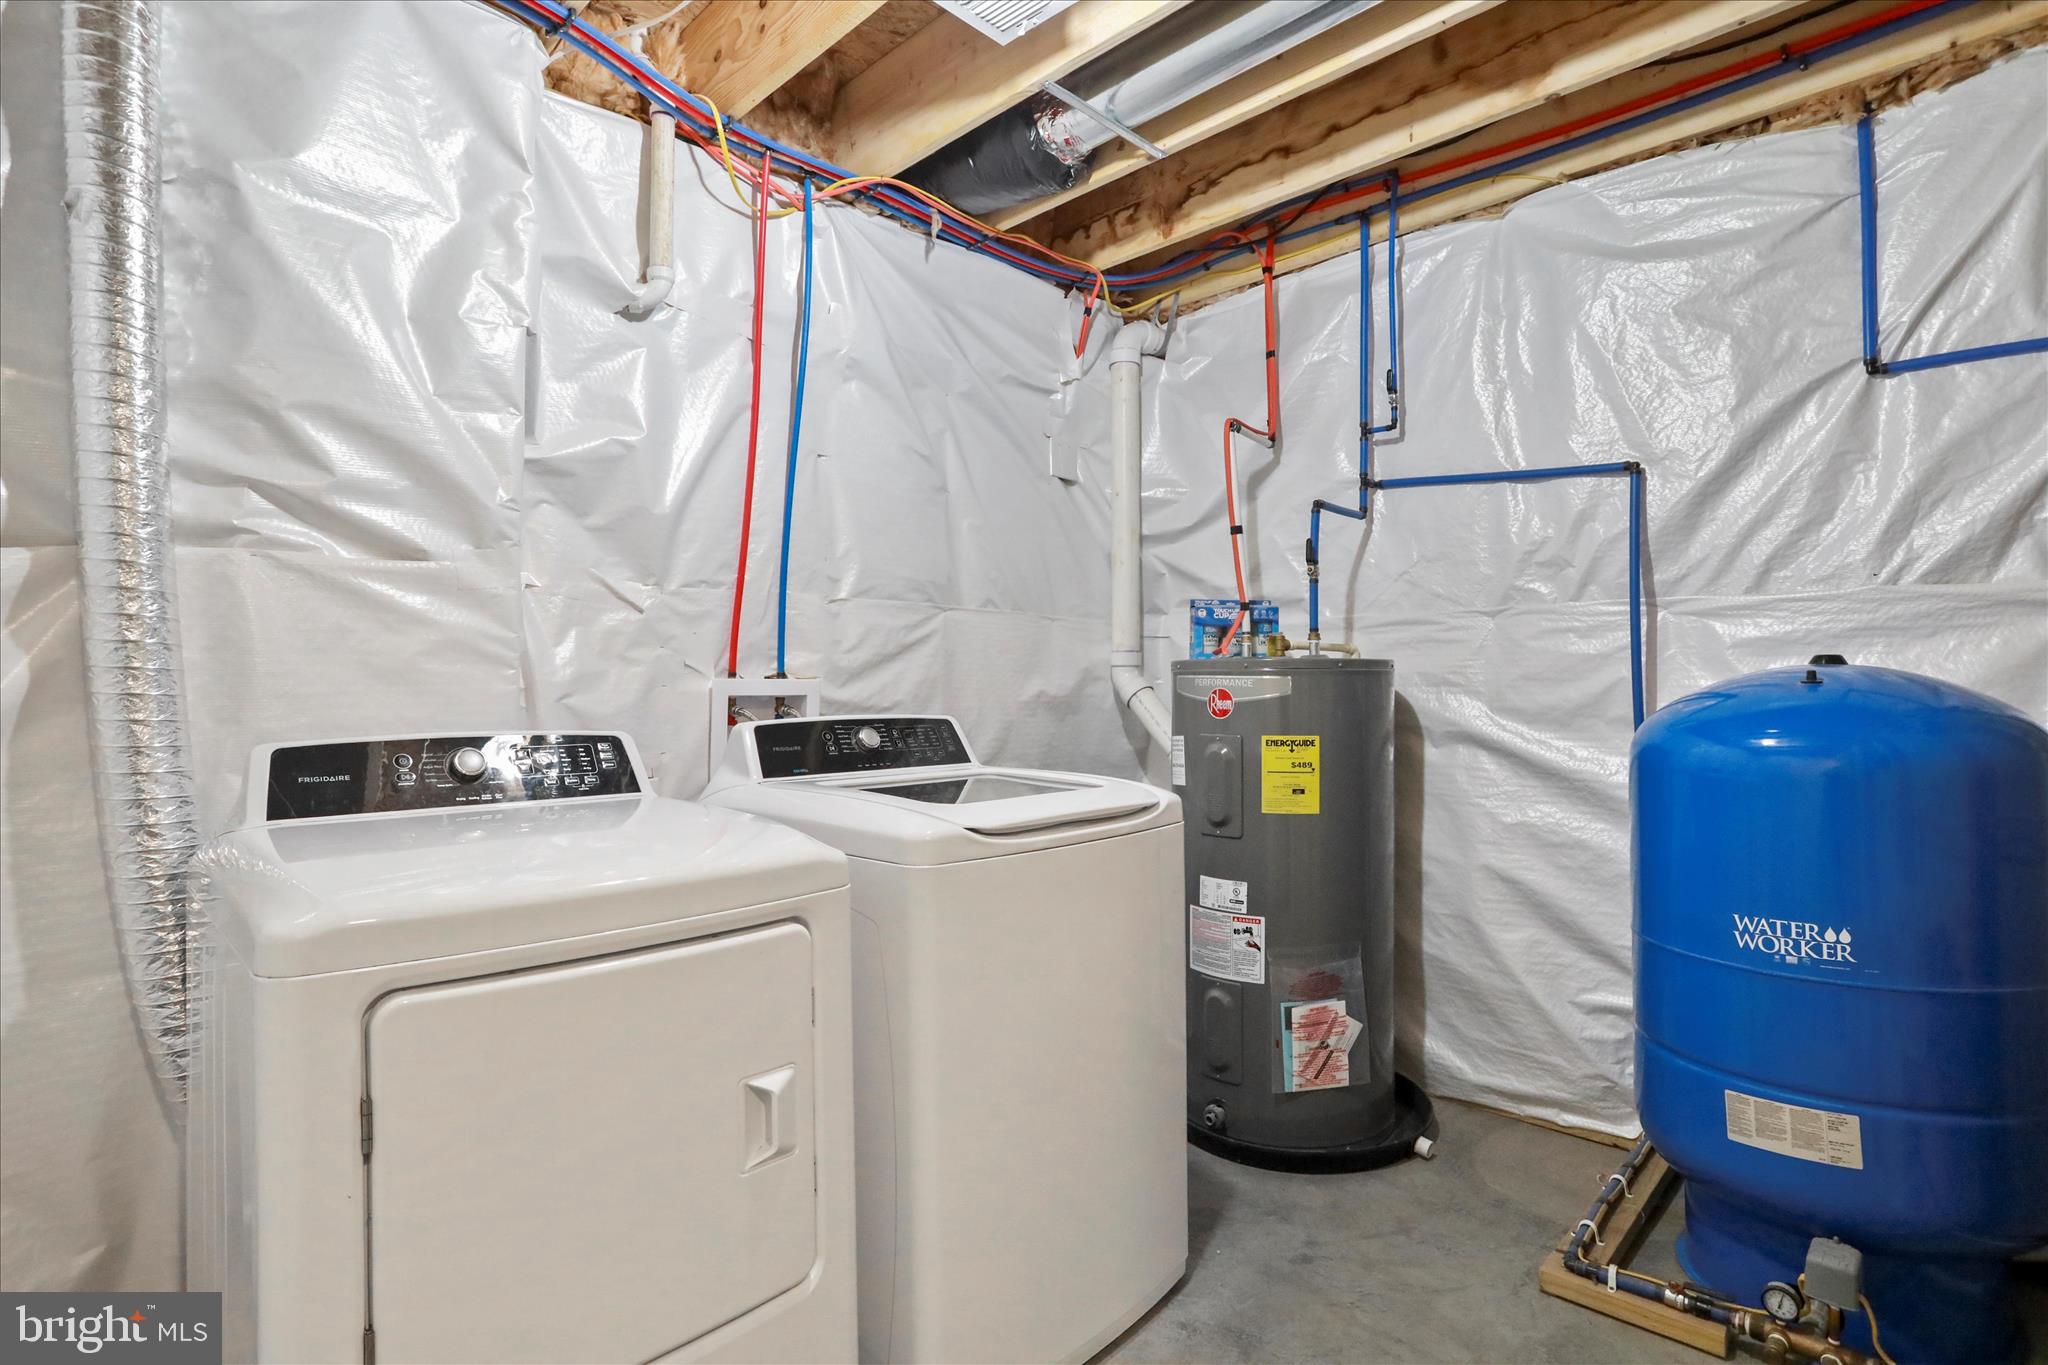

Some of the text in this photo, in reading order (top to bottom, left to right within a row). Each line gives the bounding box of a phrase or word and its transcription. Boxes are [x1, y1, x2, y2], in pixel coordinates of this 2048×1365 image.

[1194, 679, 1254, 687] PERFORMANCE
[1210, 689, 1232, 714] Rheem
[1265, 739, 1316, 748] ENERGYGUIDE
[298, 775, 351, 783] FRIGIDAIRE
[1732, 913, 1826, 942] WATER
[1733, 930, 1858, 963] WORKER
